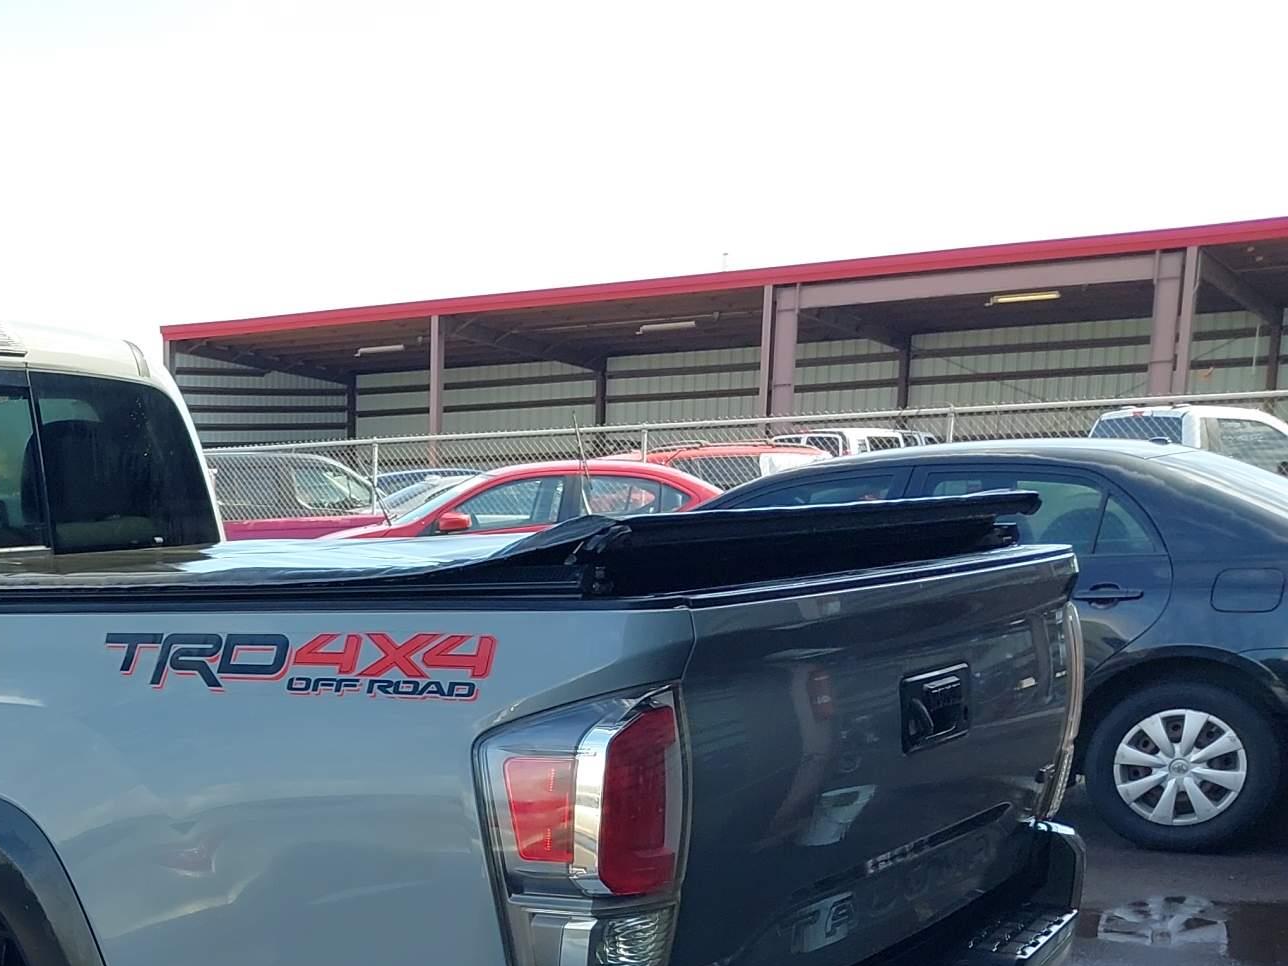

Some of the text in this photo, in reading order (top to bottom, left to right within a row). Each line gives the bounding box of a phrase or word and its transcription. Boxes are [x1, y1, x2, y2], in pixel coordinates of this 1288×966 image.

[105, 631, 497, 692] TRD 4X4
[286, 676, 478, 702] OFF ROAD
